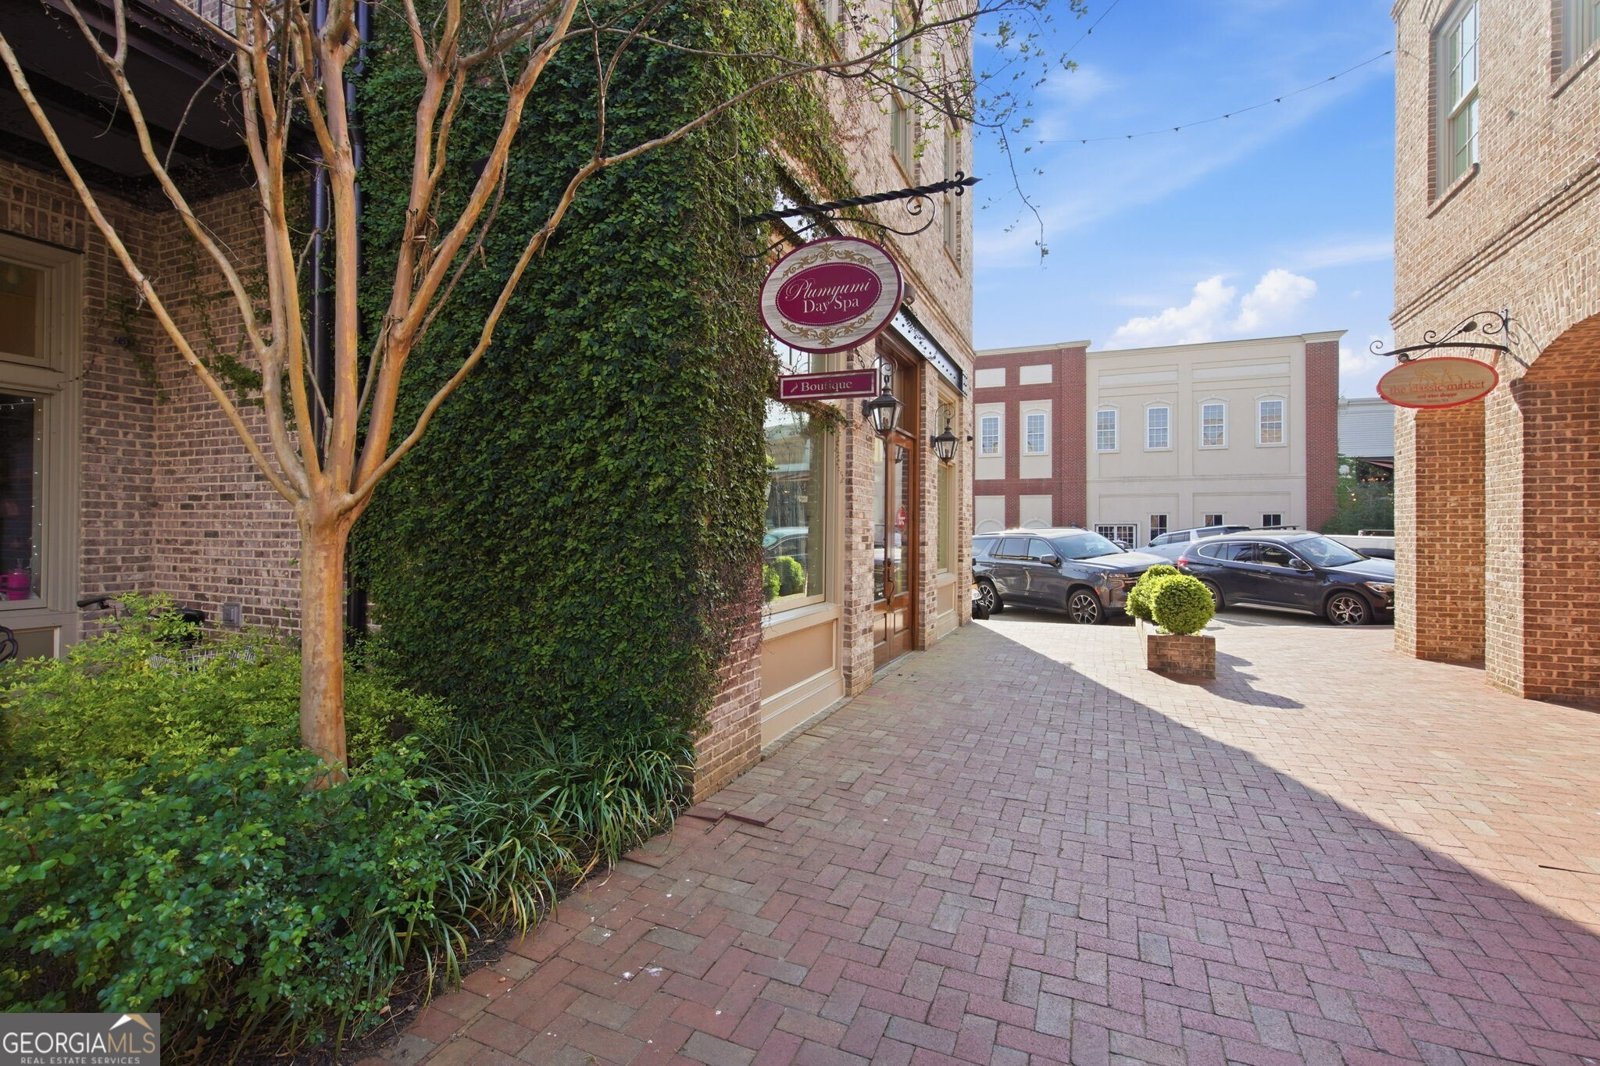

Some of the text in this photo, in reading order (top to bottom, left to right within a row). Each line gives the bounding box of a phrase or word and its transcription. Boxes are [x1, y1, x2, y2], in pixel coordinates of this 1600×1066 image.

[803, 296, 859, 314] Day Spa
[1447, 380, 1485, 391] market
